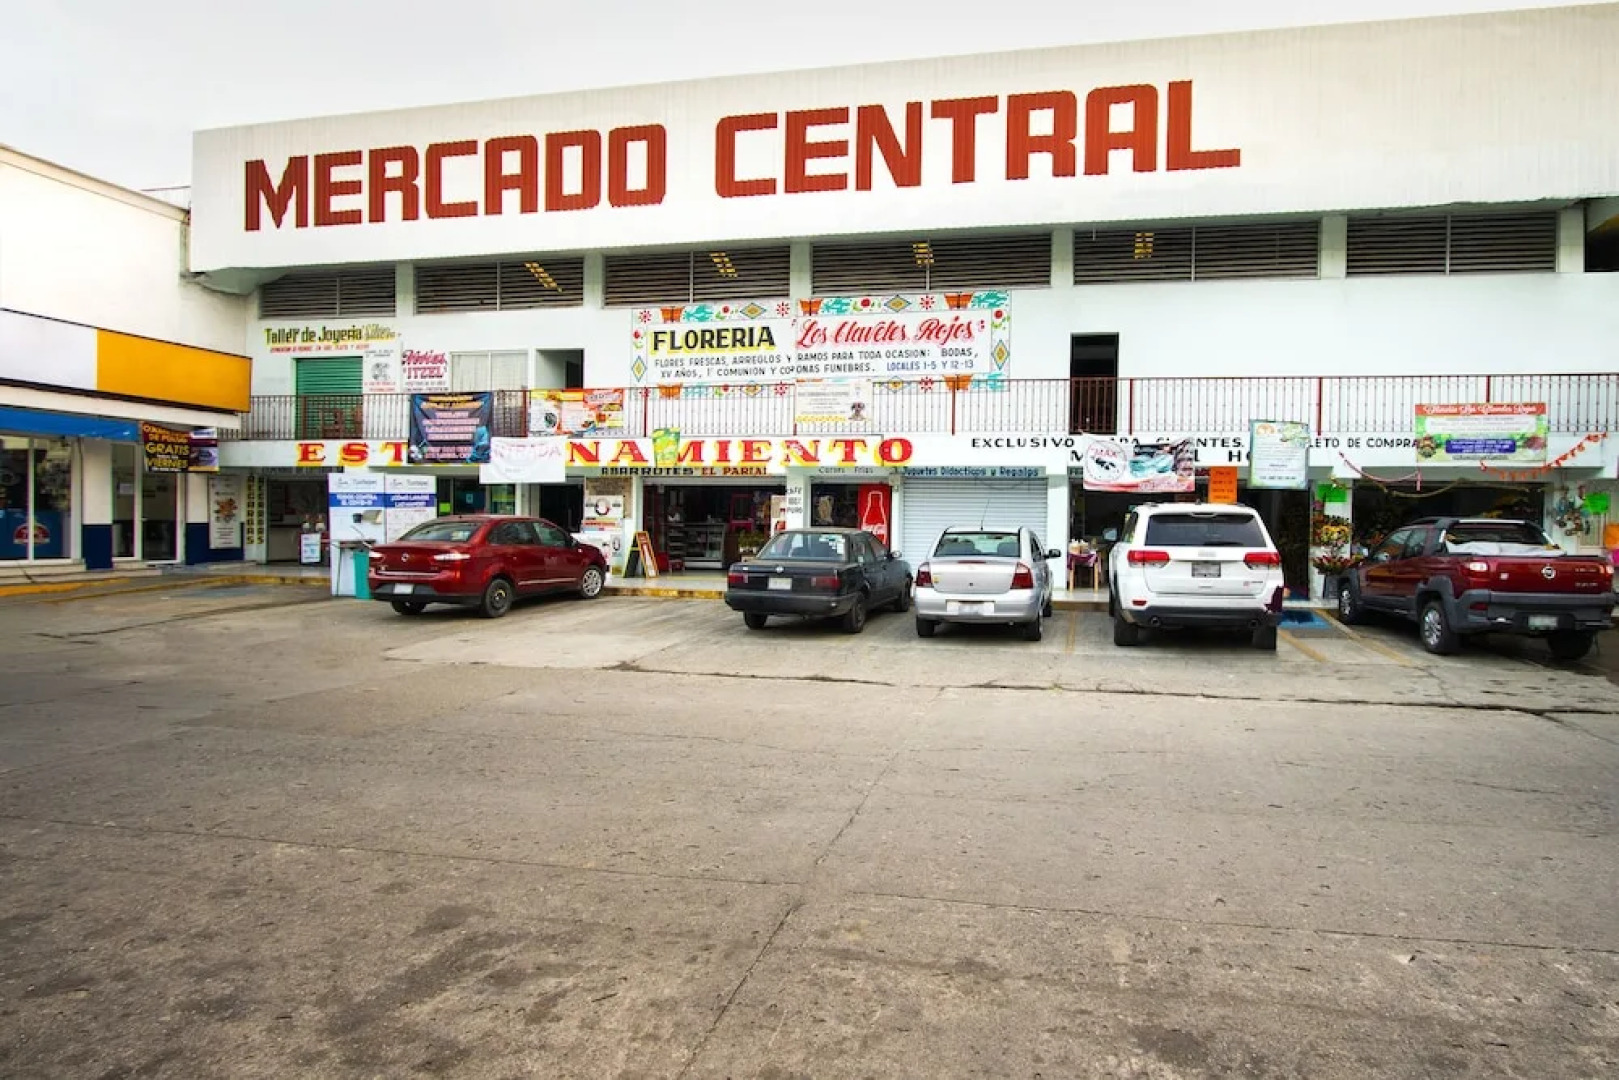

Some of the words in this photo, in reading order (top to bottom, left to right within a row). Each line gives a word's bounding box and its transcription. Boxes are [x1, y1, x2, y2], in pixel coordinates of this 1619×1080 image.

[245, 124, 667, 231] MERCADO
[715, 80, 1241, 198] CENTRAL
[264, 328, 300, 344] Taller
[301, 327, 316, 342] de
[653, 326, 776, 352] FLORERIA
[655, 358, 684, 368] FLORES
[732, 354, 781, 365] ARREGLOS
[797, 352, 828, 361] RAMOS
[832, 351, 854, 360] PARA
[859, 350, 882, 359] TODA
[660, 369, 672, 378] XV
[716, 366, 765, 376] COMUNION
[770, 365, 777, 375] Y
[887, 361, 921, 372] LOCALES
[923, 361, 936, 371] 1-5
[941, 361, 948, 370] Y
[951, 360, 974, 370] 12-13
[145, 442, 190, 455] GRATIS
[971, 437, 1075, 448] EXCLUSIVO
[1347, 438, 1360, 448] DE
